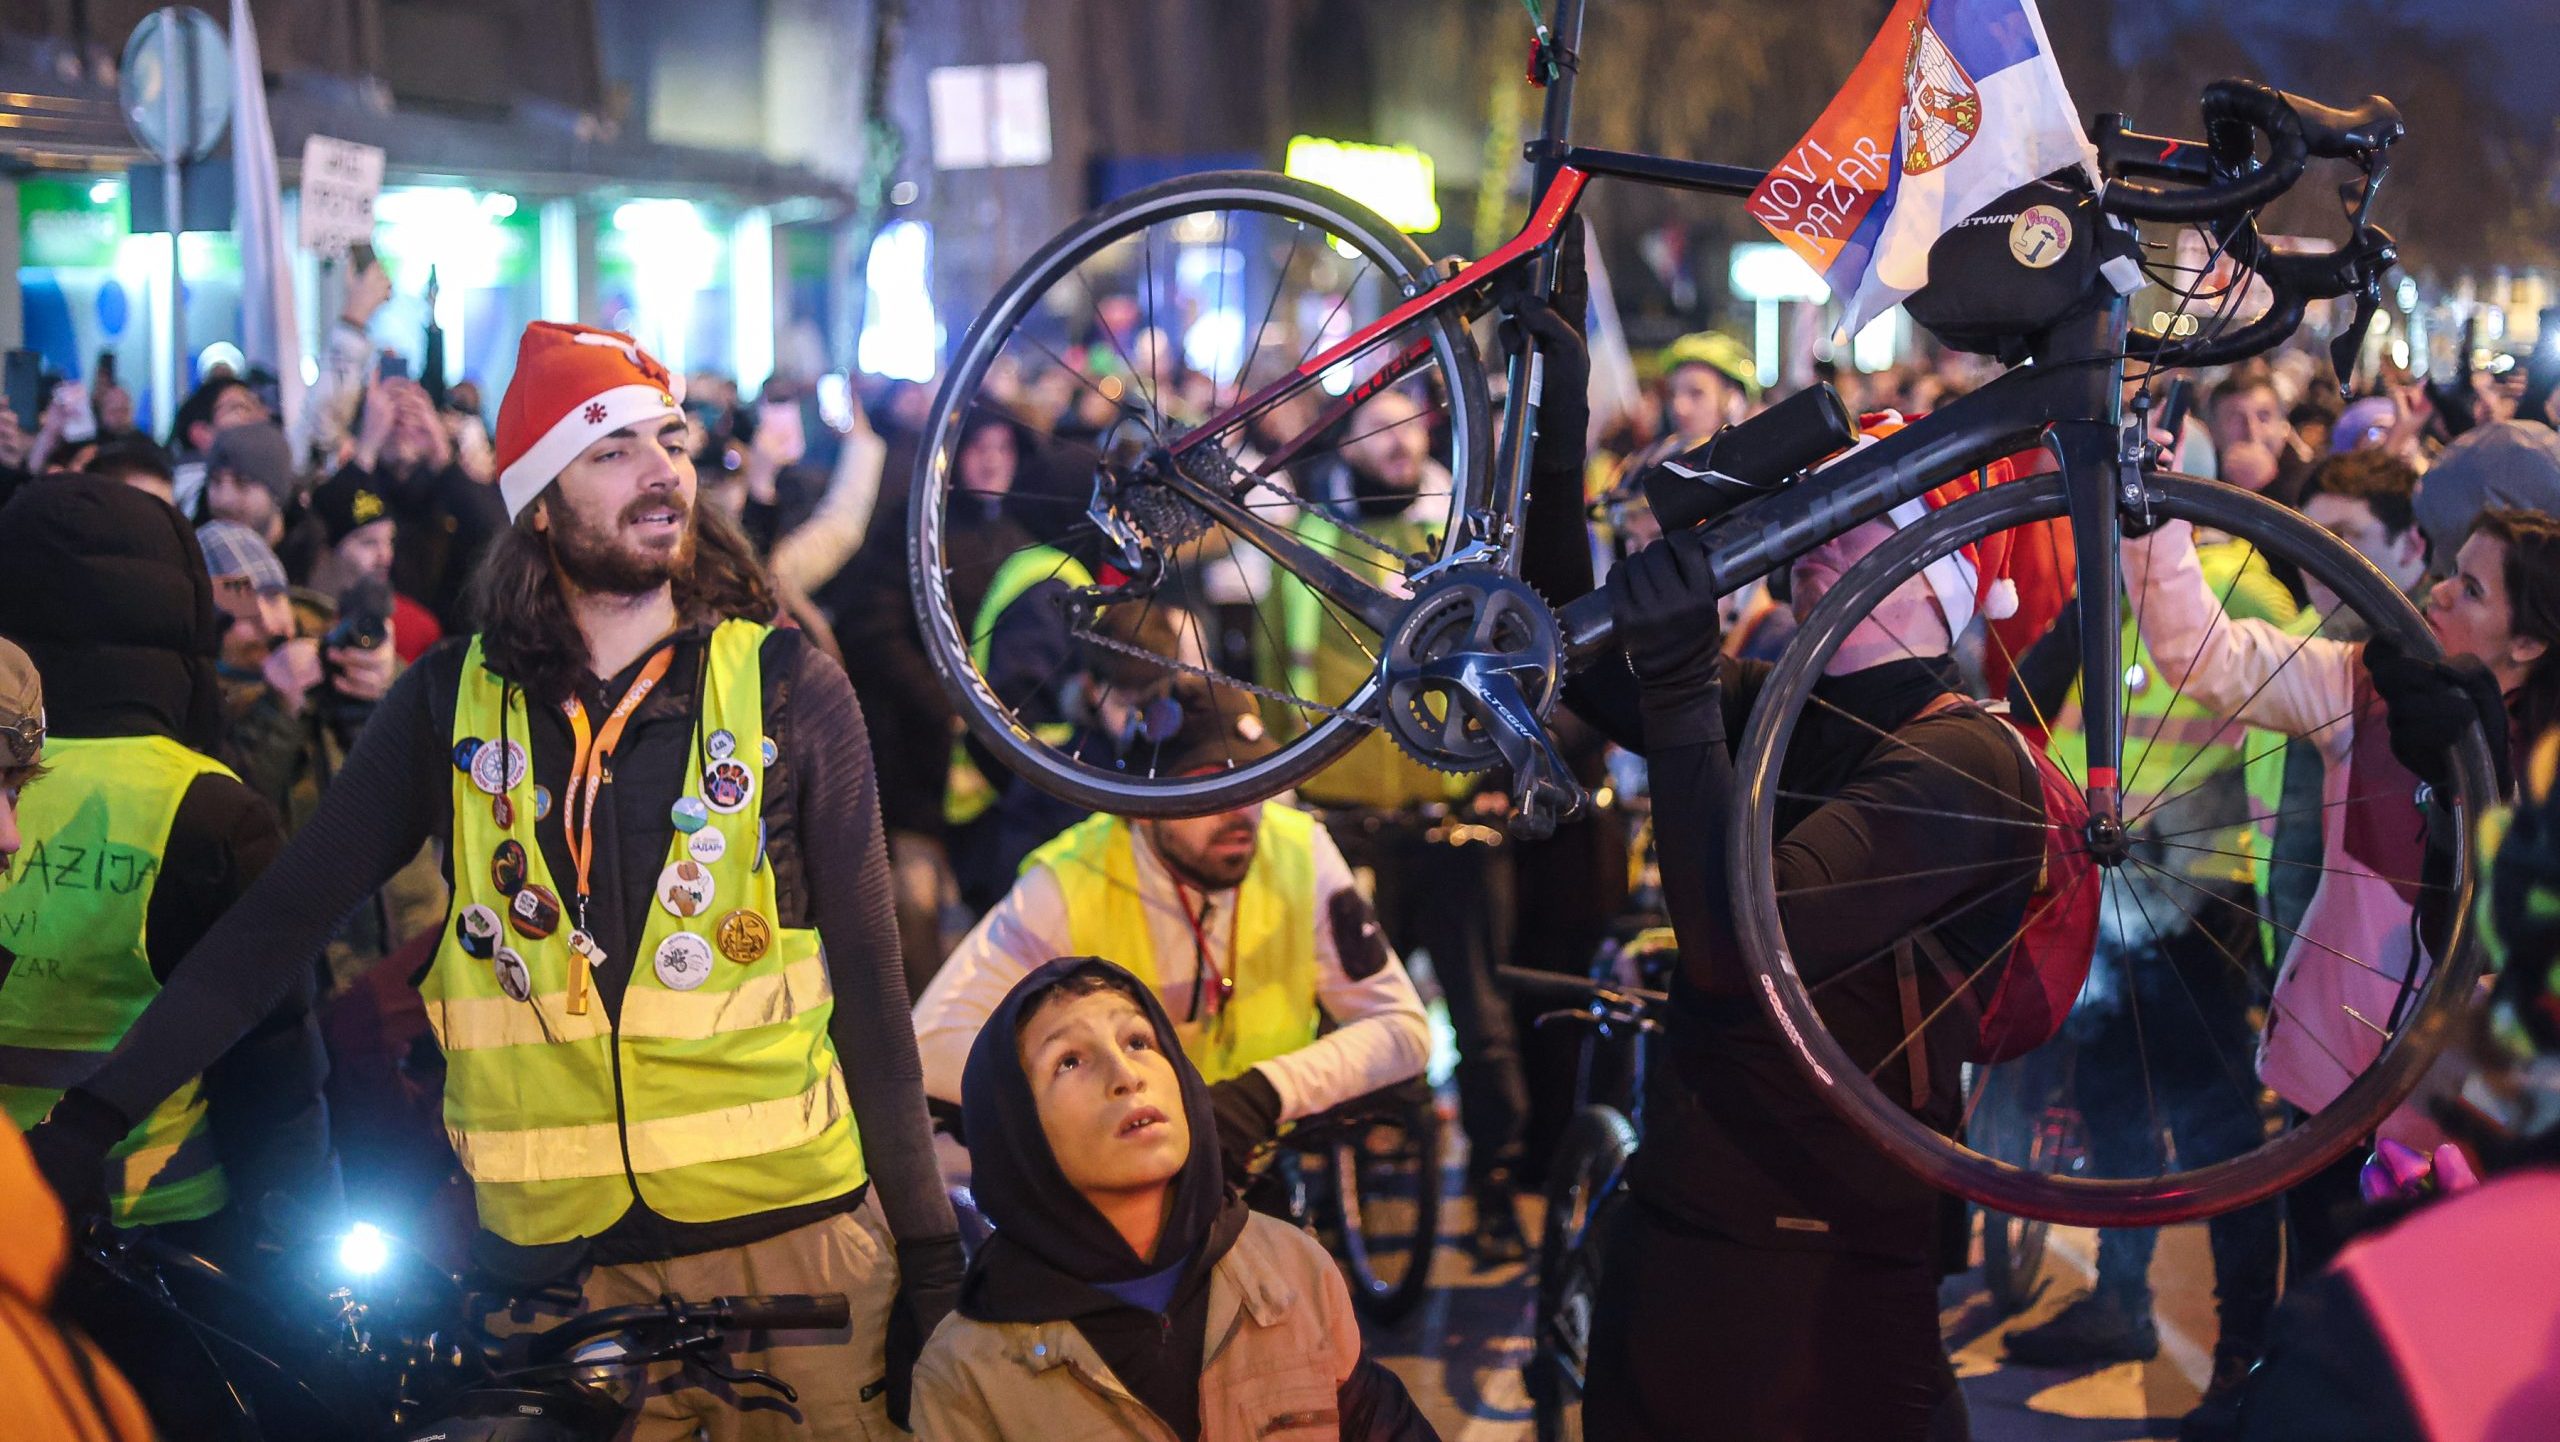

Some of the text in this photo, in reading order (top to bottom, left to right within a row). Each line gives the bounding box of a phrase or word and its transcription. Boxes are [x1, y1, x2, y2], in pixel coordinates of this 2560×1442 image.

[1759, 139, 1833, 221] NOVI
[1794, 136, 1891, 255] PAZAR
[1709, 431, 1968, 586] CUBE
[12, 954, 65, 982] ZAR
